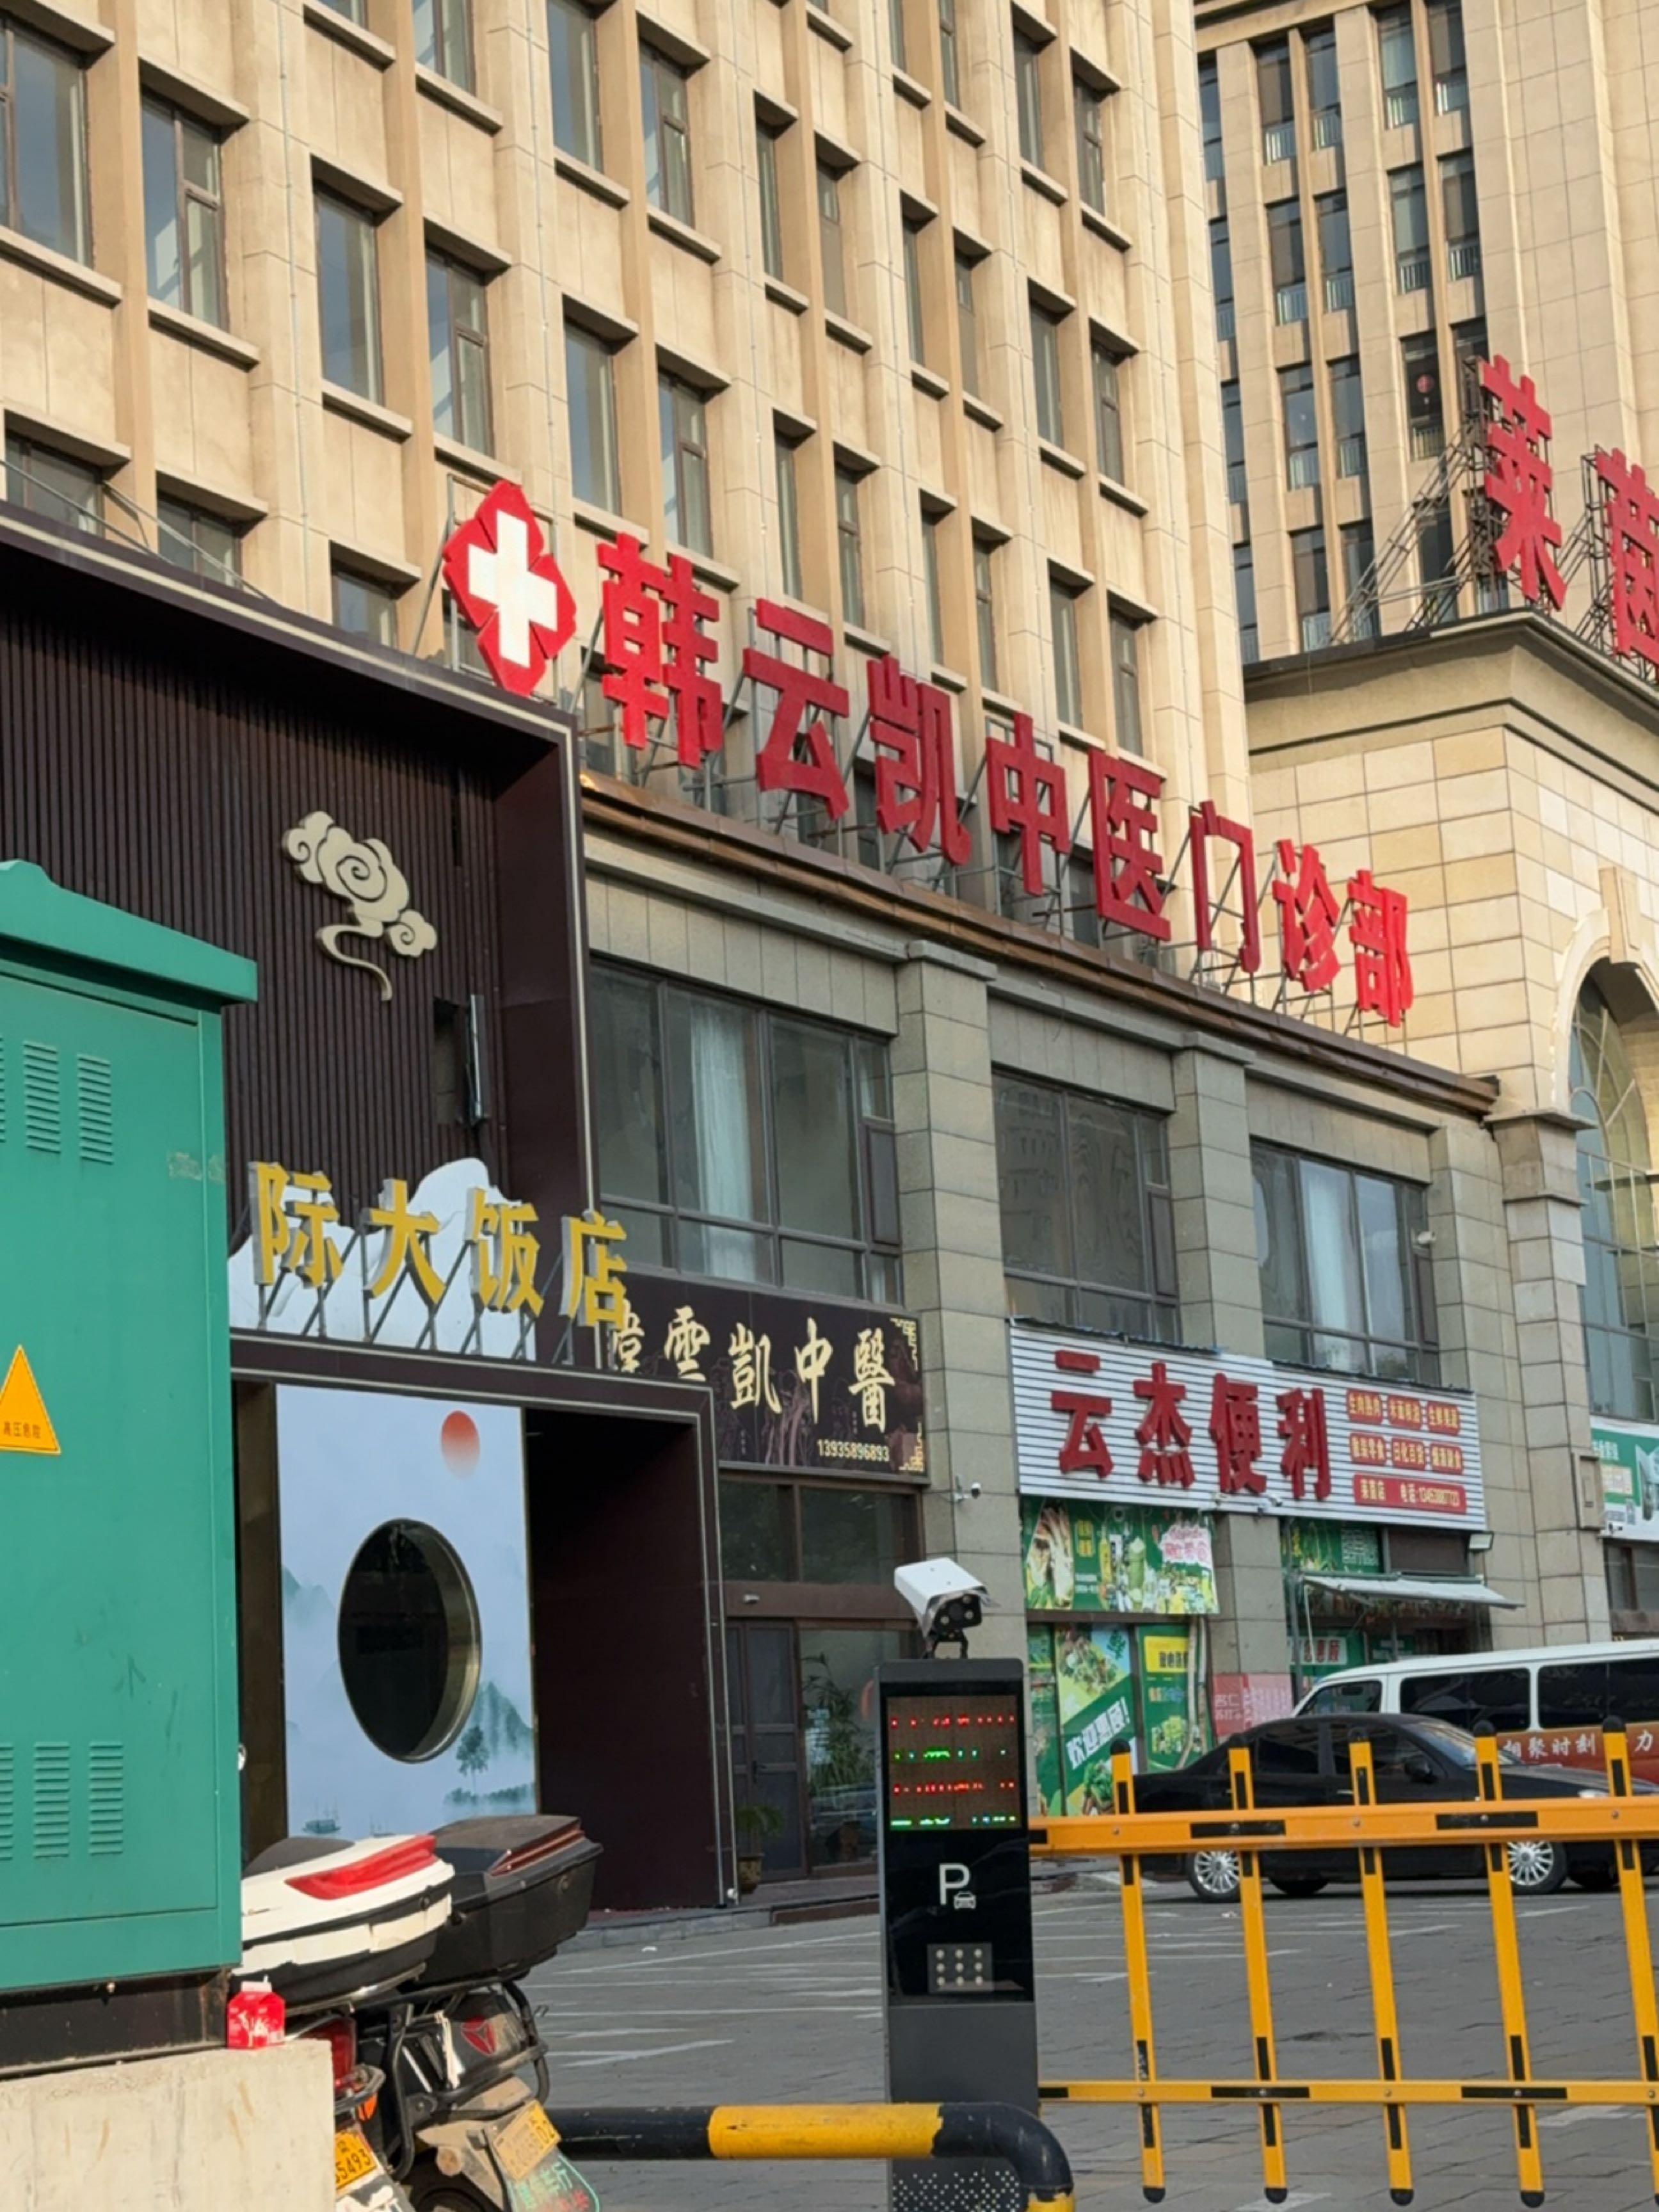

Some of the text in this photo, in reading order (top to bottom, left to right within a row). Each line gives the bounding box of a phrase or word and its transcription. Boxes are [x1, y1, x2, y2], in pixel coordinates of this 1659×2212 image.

[597, 531, 1415, 1027] 韩云凯中医门诊部
[248, 1160, 628, 1331] 际大饭店
[1051, 1349, 1332, 1501] 云杰便利
[1393, 1441, 1425, 1465] 日化百货
[939, 1863, 971, 1905] P
[335, 2147, 372, 2184] 5493
